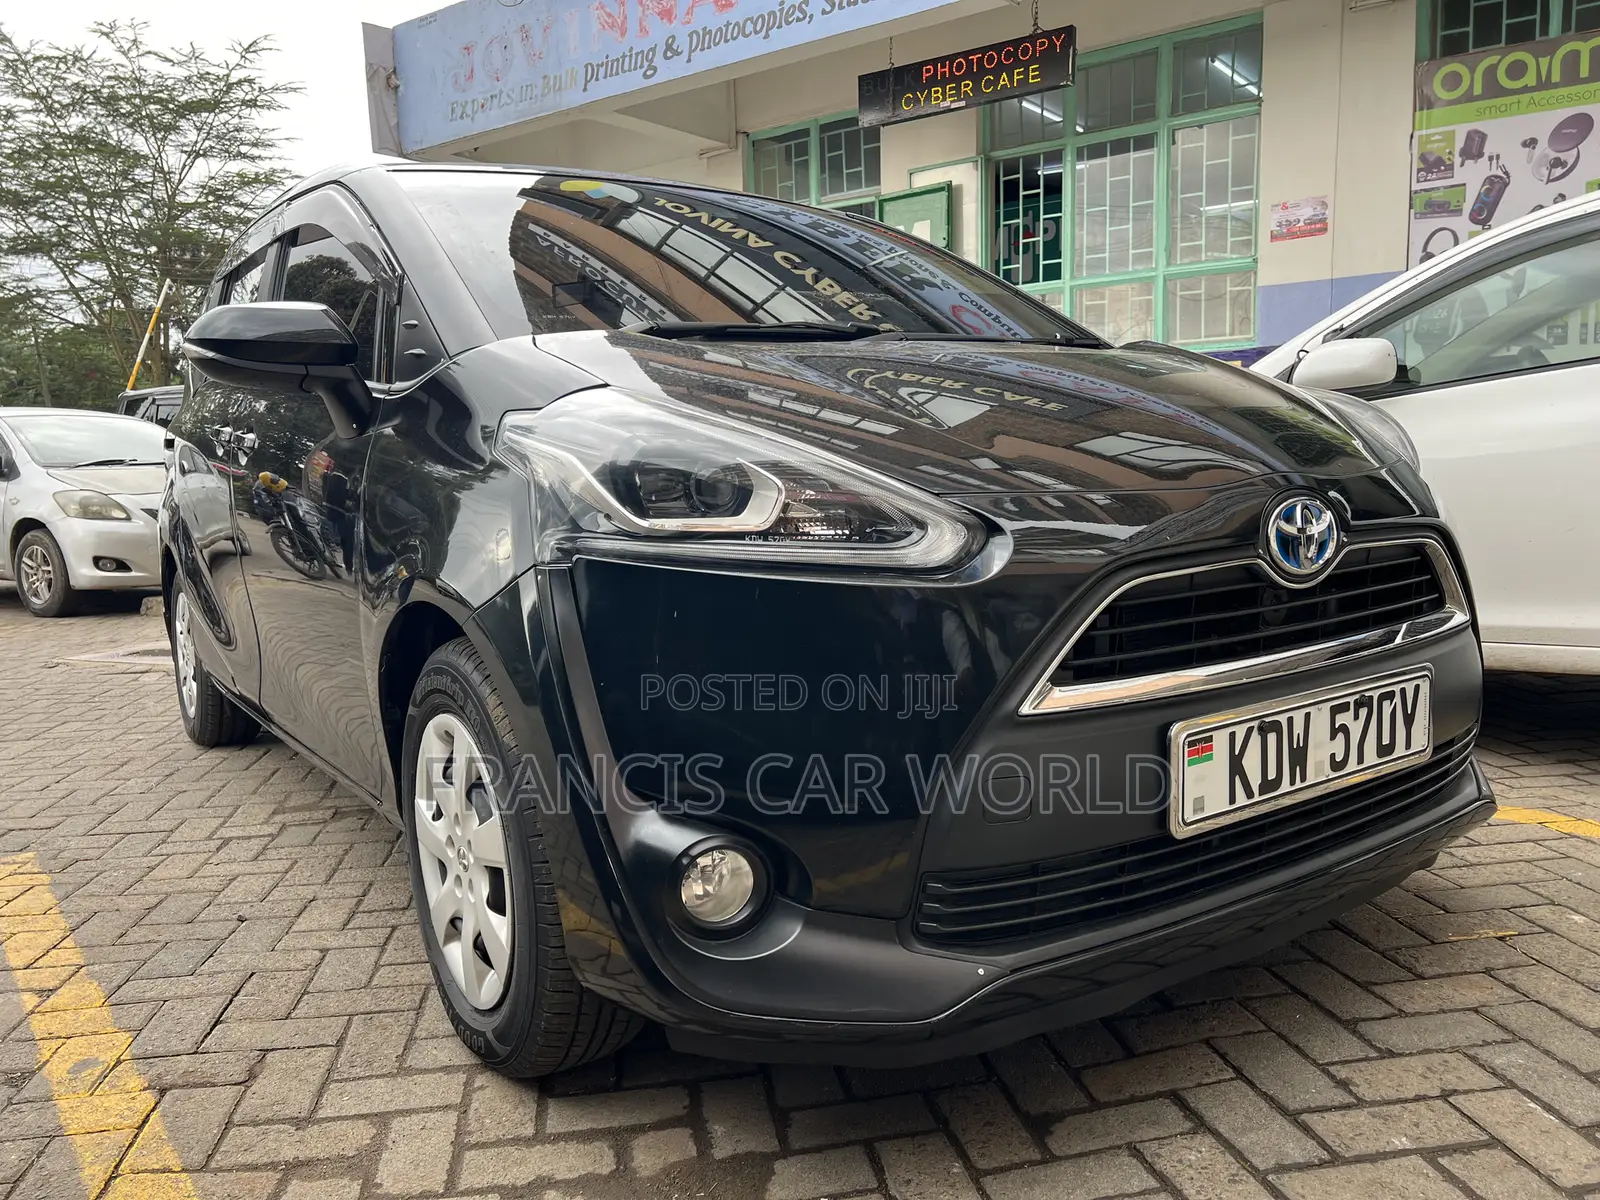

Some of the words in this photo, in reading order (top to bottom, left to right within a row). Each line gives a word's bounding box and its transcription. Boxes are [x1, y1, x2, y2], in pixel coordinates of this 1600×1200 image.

[450, 87, 516, 122] Experts
[541, 67, 579, 97] Bulk
[582, 44, 658, 92] printing
[663, 35, 683, 60] &
[922, 33, 1066, 84] PHOTOCOPY
[901, 80, 974, 111] CYBER
[981, 64, 1041, 93] CAFE
[1475, 99, 1522, 118] smart
[1229, 711, 1312, 805] KDW
[1329, 683, 1420, 773] 570Y
